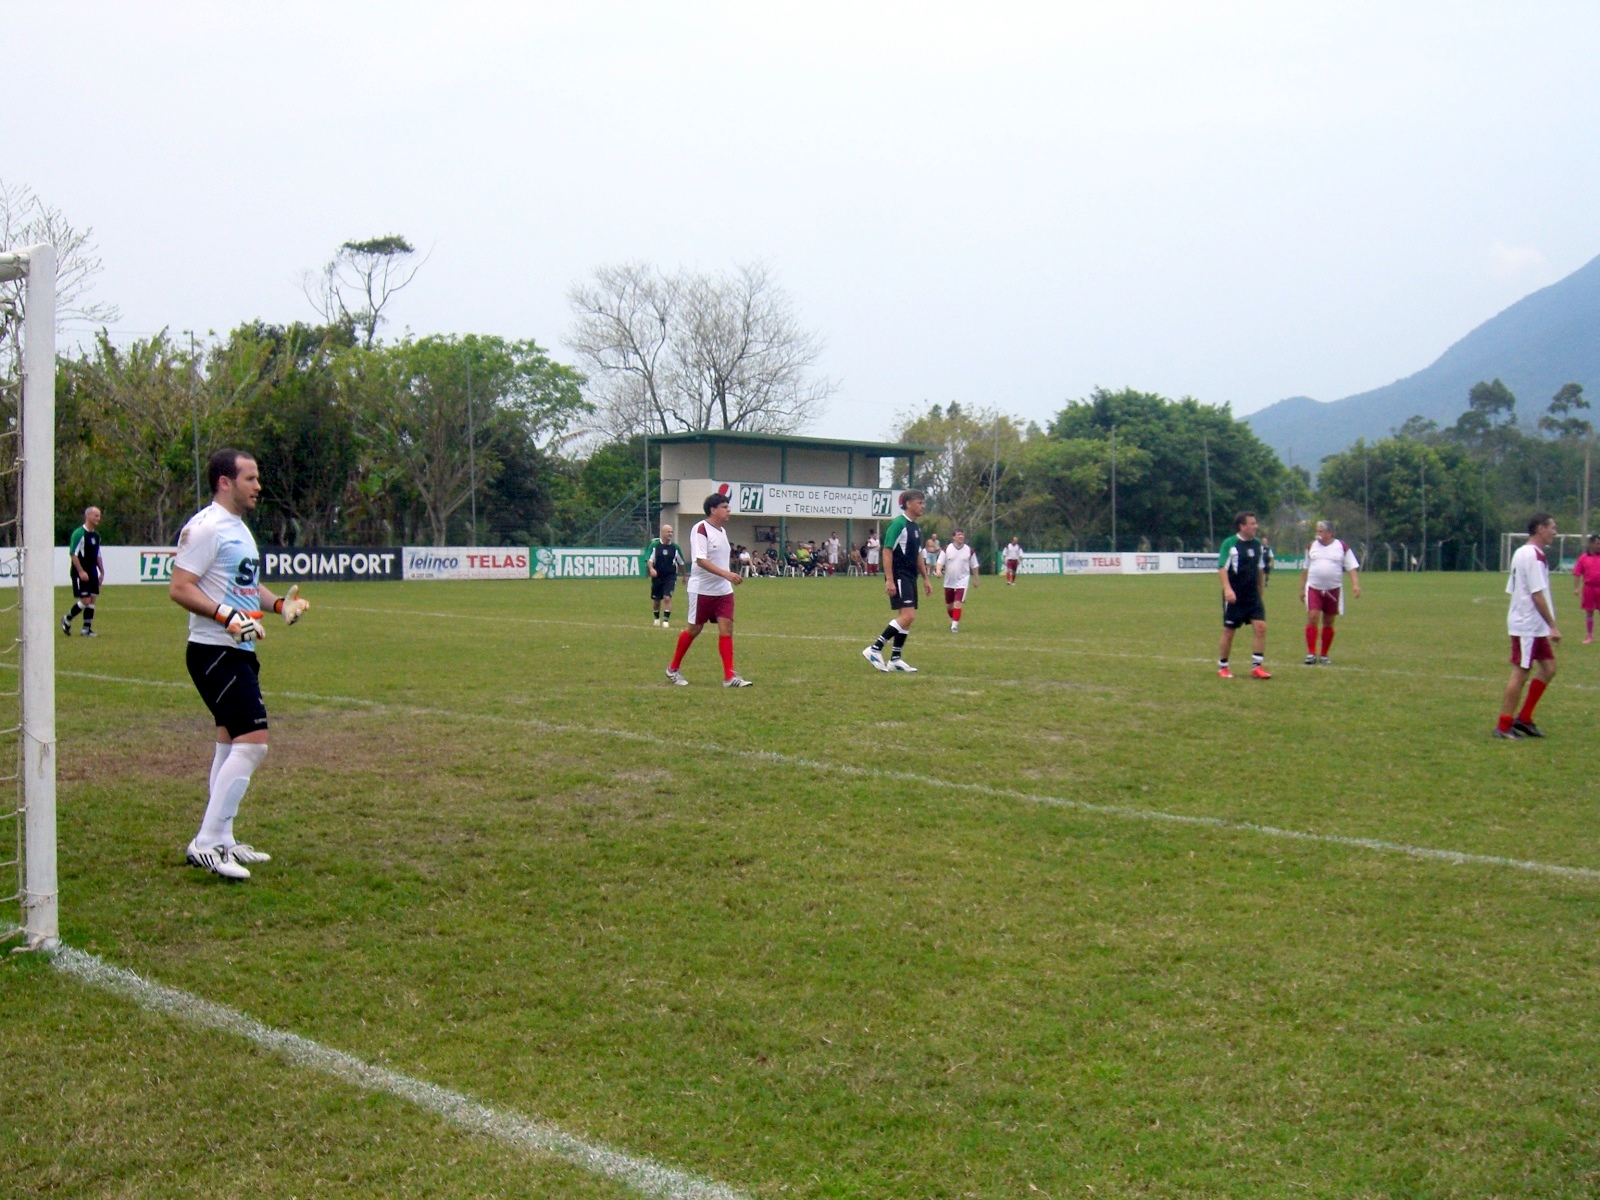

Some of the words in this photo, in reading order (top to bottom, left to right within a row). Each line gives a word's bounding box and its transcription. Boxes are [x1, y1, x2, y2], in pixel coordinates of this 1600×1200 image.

[808, 491, 820, 499] DE
[794, 503, 853, 515] TREINAMENTO
[265, 553, 395, 575] PROIMPORT
[408, 550, 459, 574] Telinco
[466, 555, 527, 569] TELAS
[1092, 557, 1121, 566] TELAS
